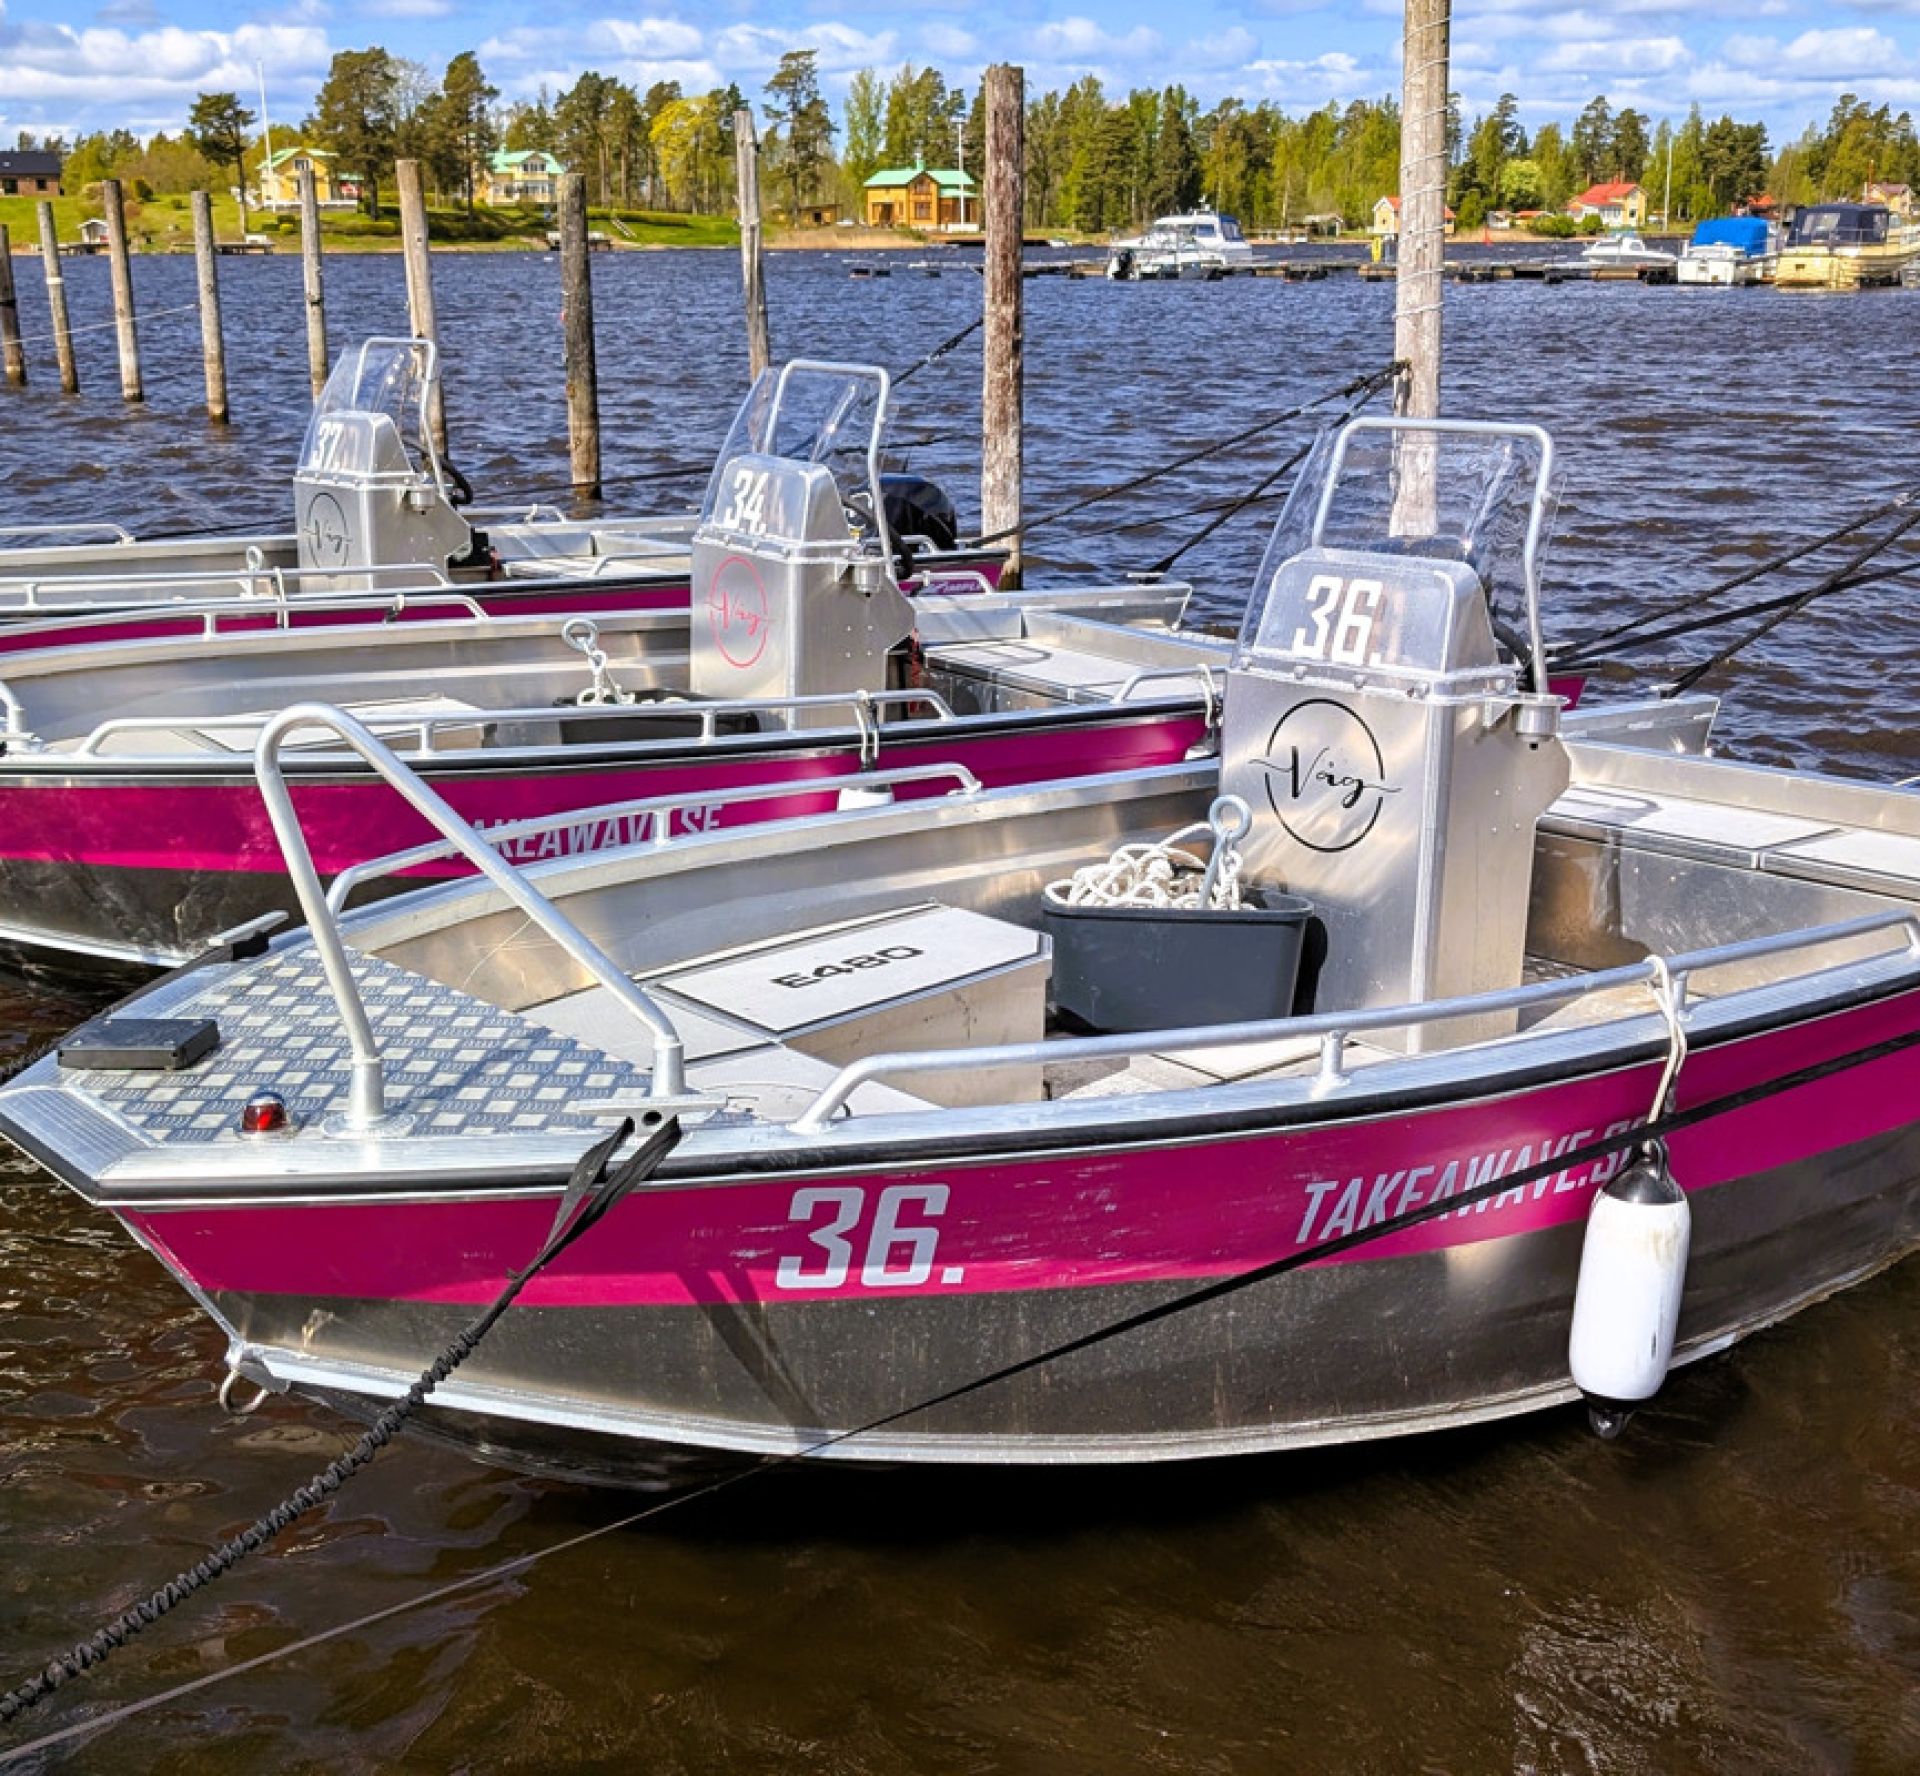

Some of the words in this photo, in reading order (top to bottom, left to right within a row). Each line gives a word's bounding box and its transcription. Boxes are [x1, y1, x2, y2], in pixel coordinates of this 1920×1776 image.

[724, 470, 769, 535] 34.
[1292, 575, 1384, 667] 36.
[776, 1184, 965, 1289] 36.
